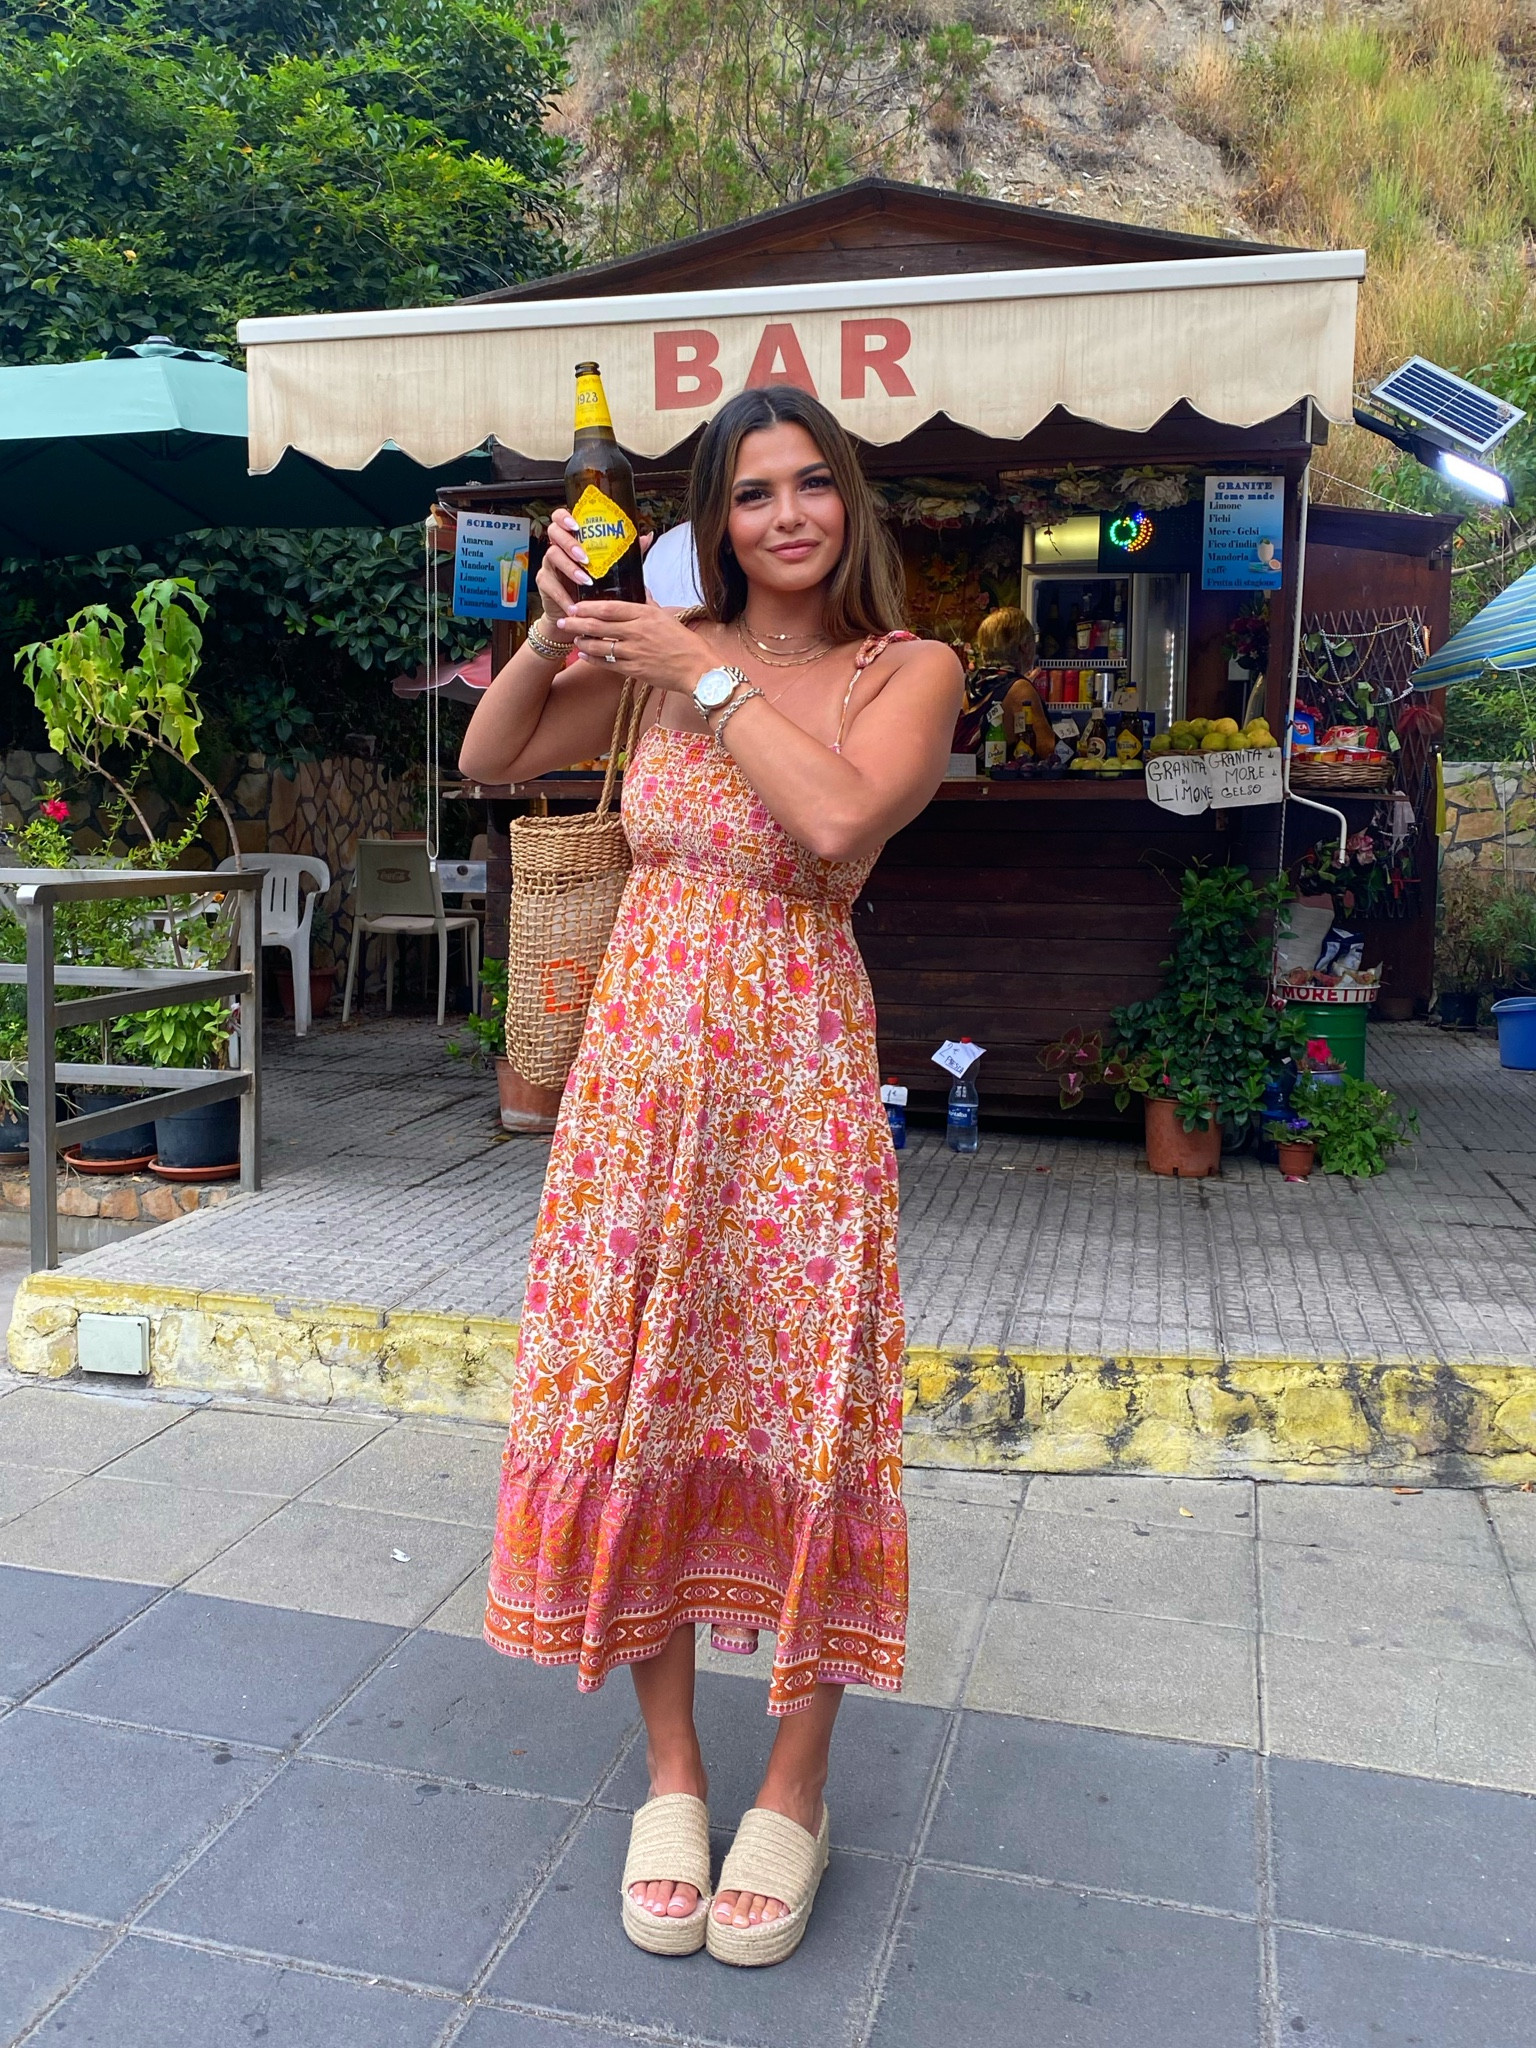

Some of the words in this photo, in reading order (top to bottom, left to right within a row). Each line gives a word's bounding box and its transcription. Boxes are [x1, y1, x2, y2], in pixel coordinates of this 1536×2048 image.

[654, 318, 916, 410] BAR
[1217, 482, 1272, 490] GRANITE
[1215, 492, 1244, 500] Home
[1248, 492, 1275, 500] made
[1209, 502, 1241, 510] Limone
[1209, 514, 1231, 522] Fichi
[466, 519, 521, 531] SCIROPPI
[1209, 527, 1231, 535] More
[1237, 527, 1259, 535] Gelsi
[462, 535, 494, 546] Amarena
[1208, 540, 1226, 548] Fico
[461, 547, 484, 557] Menta
[1208, 553, 1249, 561] Mandorla
[461, 560, 495, 571] Mandorla
[460, 572, 487, 583] Limone
[459, 585, 498, 596] Mandarino
[459, 597, 498, 608] Tamarindo
[1148, 761, 1207, 781] GRANITA
[1225, 766, 1264, 784] MORE
[1221, 784, 1261, 798] GELSO
